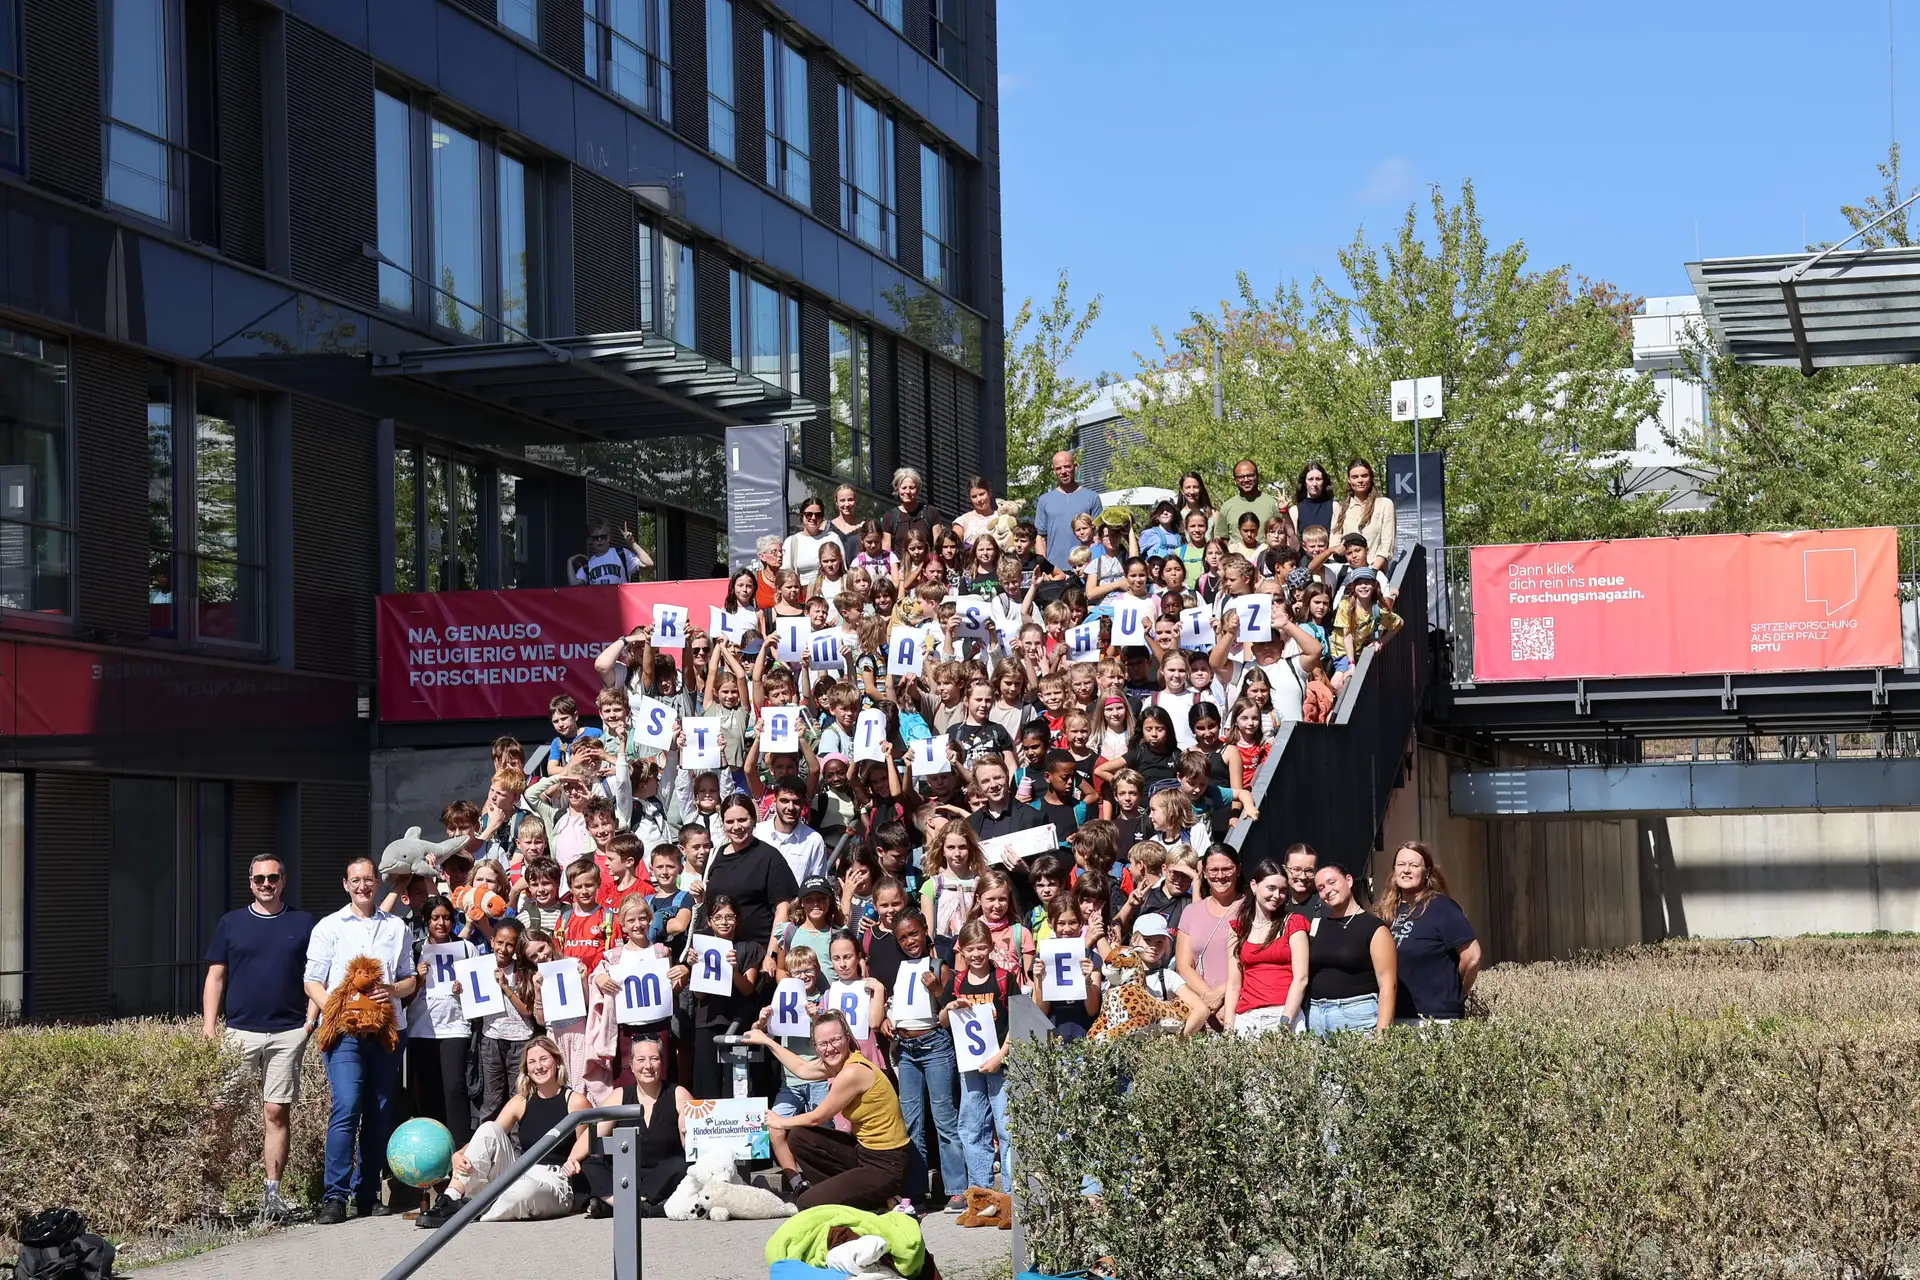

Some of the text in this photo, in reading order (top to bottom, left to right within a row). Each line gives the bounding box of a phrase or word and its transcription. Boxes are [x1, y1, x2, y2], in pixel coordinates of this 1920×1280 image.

[1394, 472, 1415, 494] K
[1508, 562, 1575, 576] Dann klick
[1508, 576, 1624, 590] dich rein ins neue
[1509, 587, 1645, 604] Forschungsmagazin.
[661, 612, 677, 637] K
[721, 612, 733, 633] L
[966, 607, 980, 630] S
[1121, 608, 1137, 636] U
[1188, 611, 1202, 635] T
[1247, 604, 1261, 632] Z
[1750, 620, 1857, 632] SPITZENFORSCHUNG
[408, 623, 541, 646] NA, GENAUSO
[790, 626, 797, 652] I
[1075, 627, 1091, 652] H
[1751, 633, 1771, 642] AUS
[1773, 632, 1794, 642] DER
[409, 646, 516, 666] NEUGIERIG
[520, 644, 555, 661] WIE
[899, 637, 915, 665] A
[1751, 643, 1781, 652] RPTU
[409, 665, 567, 687] FORSCHENDEN?
[647, 707, 666, 736] S
[771, 713, 788, 742] A
[694, 728, 709, 757] T
[436, 954, 457, 983] K
[703, 948, 722, 981] A
[1055, 952, 1073, 986] E
[470, 970, 490, 1004] L
[557, 973, 567, 1006] I
[907, 972, 917, 1006] I
[780, 992, 798, 1024] K
[842, 992, 858, 1026] R
[965, 1020, 986, 1056] S
[693, 1124, 761, 1136] Kinderklimakonferenz
[714, 1118, 739, 1127] Landauer
